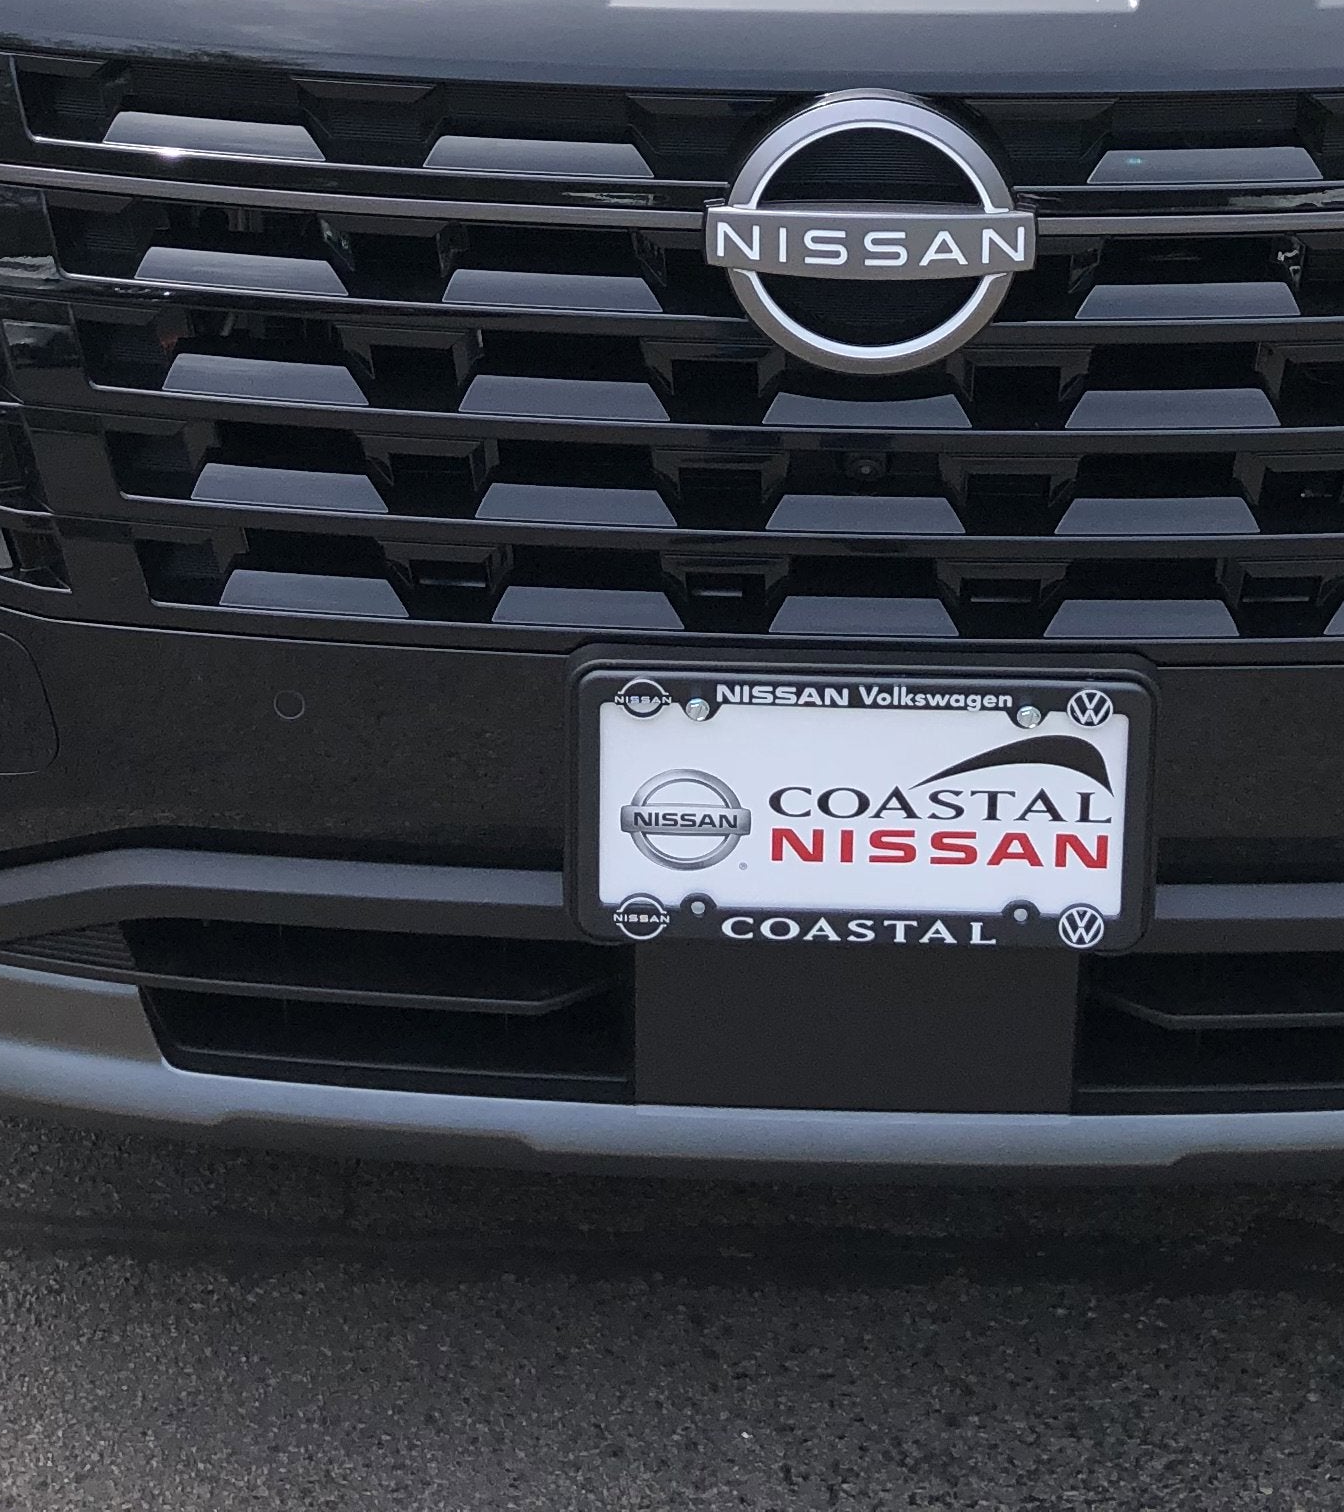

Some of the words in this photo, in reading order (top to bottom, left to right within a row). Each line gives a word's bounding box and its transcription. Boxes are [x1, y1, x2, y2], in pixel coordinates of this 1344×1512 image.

[716, 221, 1026, 267] NISSAN
[614, 694, 672, 705] NISSAN
[716, 683, 849, 706] NISSAN
[859, 685, 1013, 711] Volkswagen
[768, 785, 1112, 825] COASTAL
[633, 811, 738, 829] NISSAN
[771, 828, 1109, 870] NISSAN
[613, 913, 671, 924] NISSAN
[721, 916, 997, 945] COASTAL
